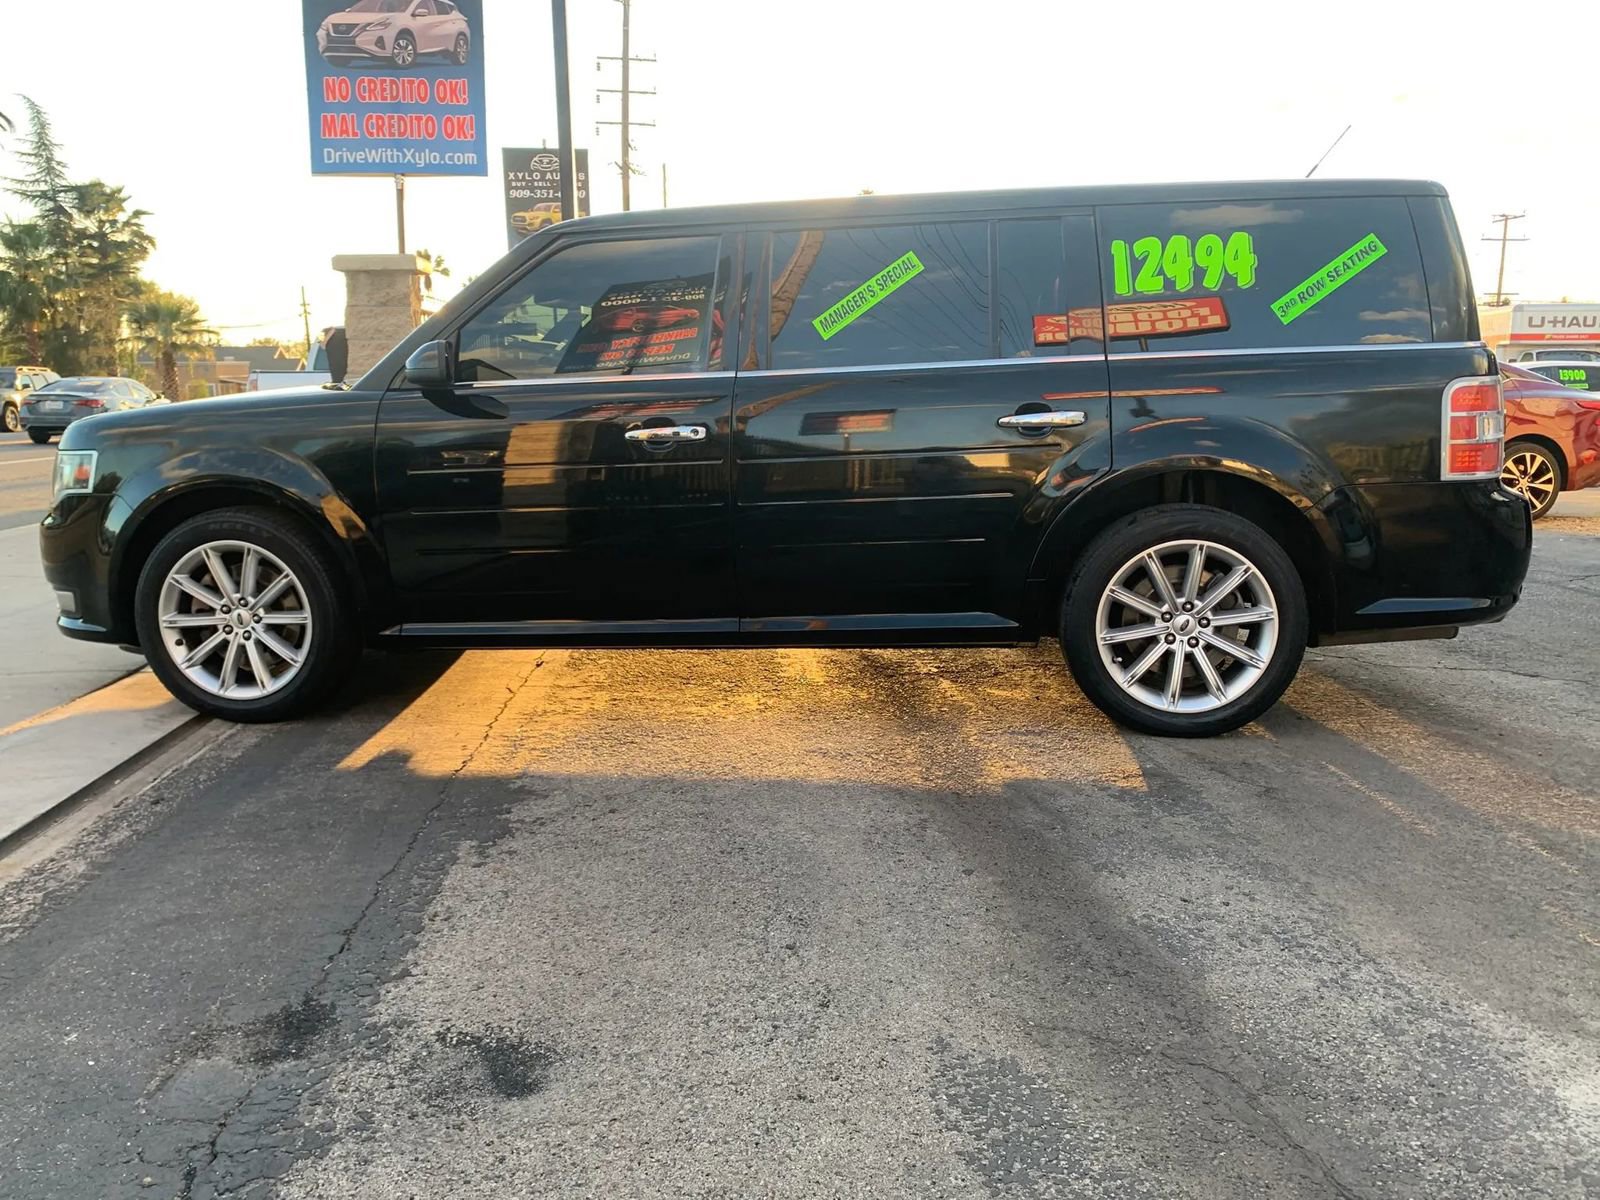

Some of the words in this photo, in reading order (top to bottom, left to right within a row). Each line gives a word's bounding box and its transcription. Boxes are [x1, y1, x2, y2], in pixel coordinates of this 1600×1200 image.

[323, 76, 351, 103] NO
[356, 76, 430, 104] CREDITO
[434, 78, 469, 105] OK!
[320, 112, 361, 139] MAL
[363, 113, 437, 140] CREDITO
[442, 114, 476, 141] OK!
[323, 147, 478, 167] DriveWithXylo.com
[508, 172, 541, 180] XYLO
[1111, 231, 1258, 296] 12494
[1277, 297, 1297, 318] 3RD
[1297, 276, 1326, 305] ROW
[1326, 240, 1378, 283] SEATING
[819, 284, 877, 333] MANAGER'S
[875, 256, 917, 292] SPECIAL
[1528, 315, 1600, 328] U-HAU
[1559, 369, 1586, 381] 13900
